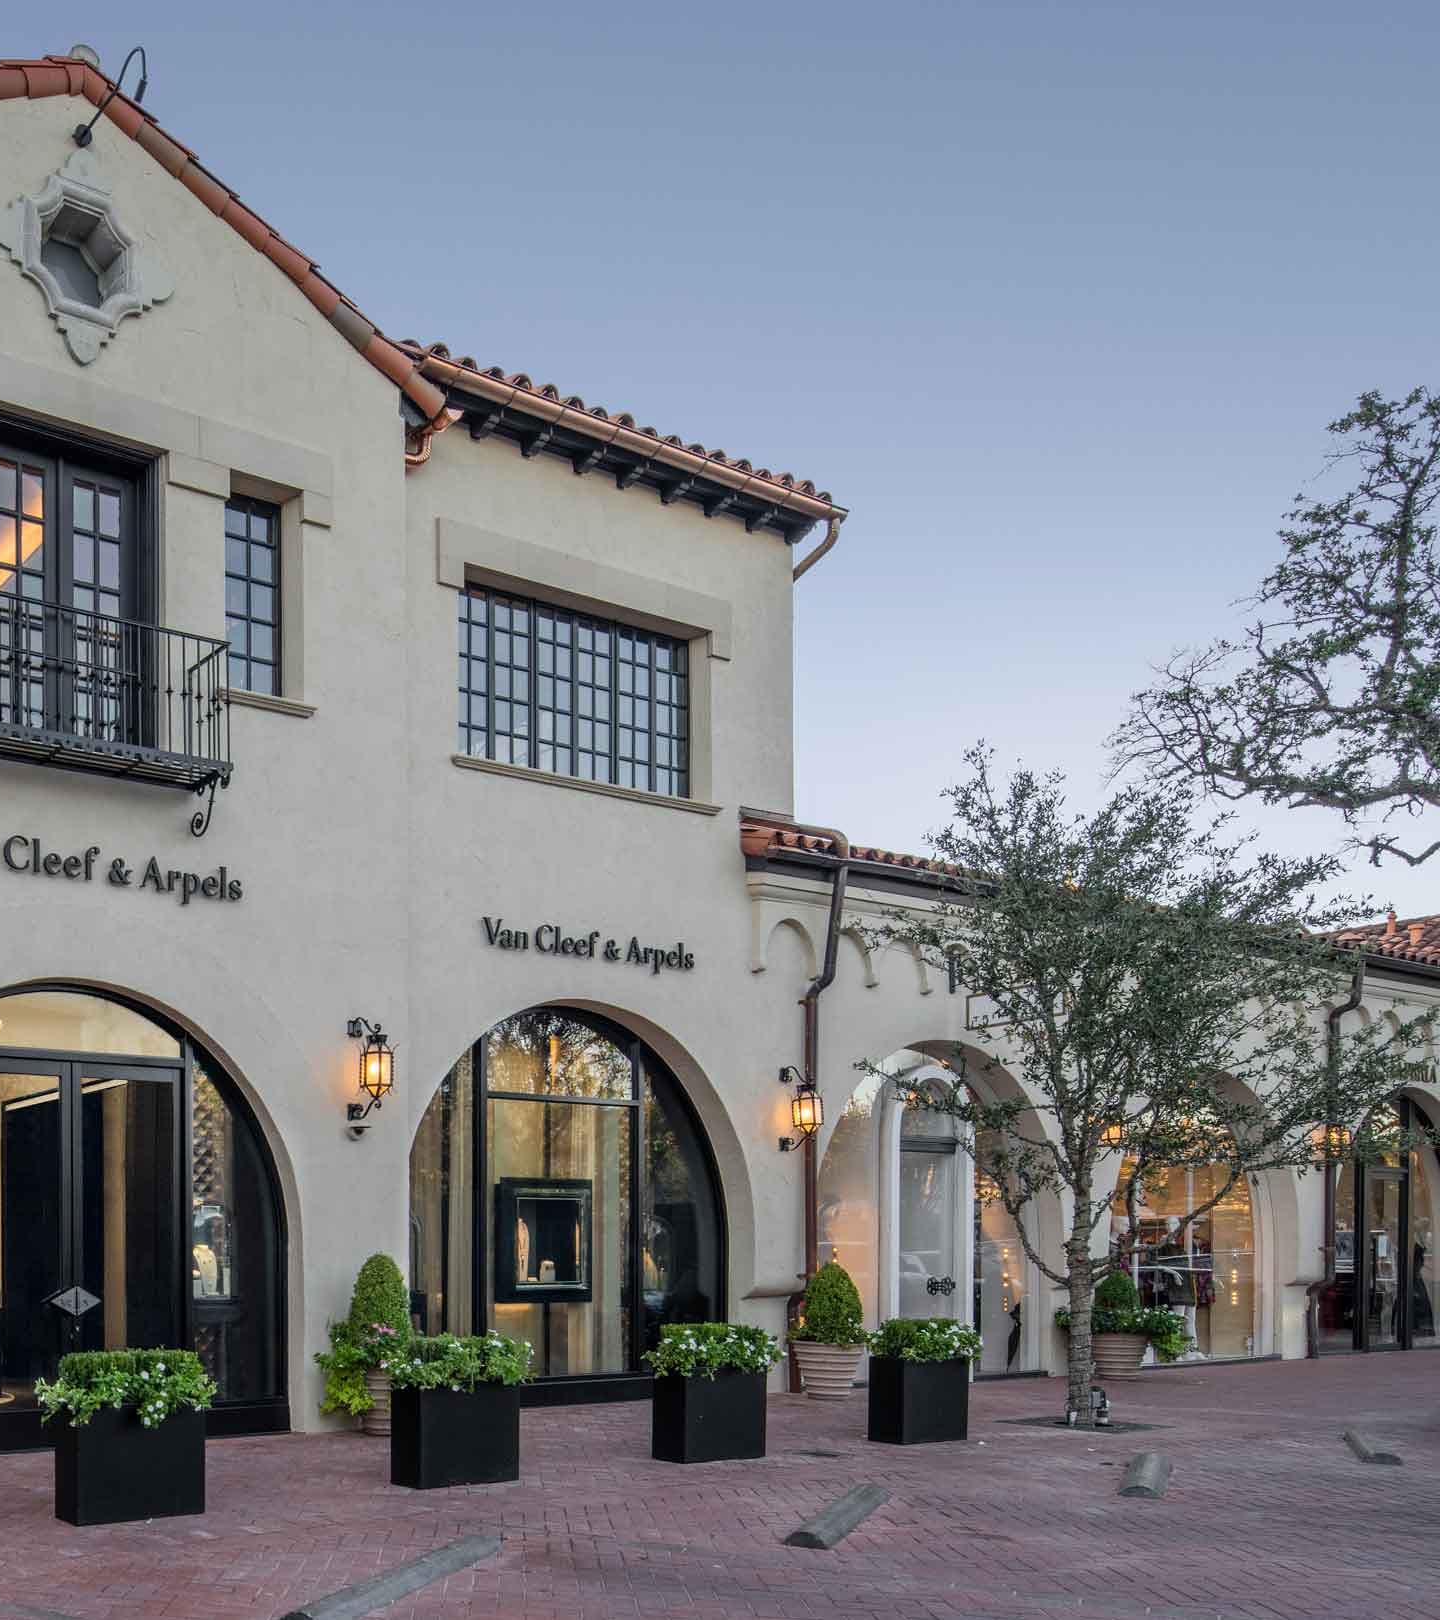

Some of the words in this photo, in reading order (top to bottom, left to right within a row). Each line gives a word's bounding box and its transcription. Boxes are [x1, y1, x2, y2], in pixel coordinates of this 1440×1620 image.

[2, 834, 101, 883] Cleef
[106, 857, 134, 889] &
[139, 855, 243, 907] Arpels
[482, 916, 529, 953] Van
[534, 924, 601, 961] Cleef
[603, 939, 622, 964] &
[625, 936, 695, 976] Arpels
